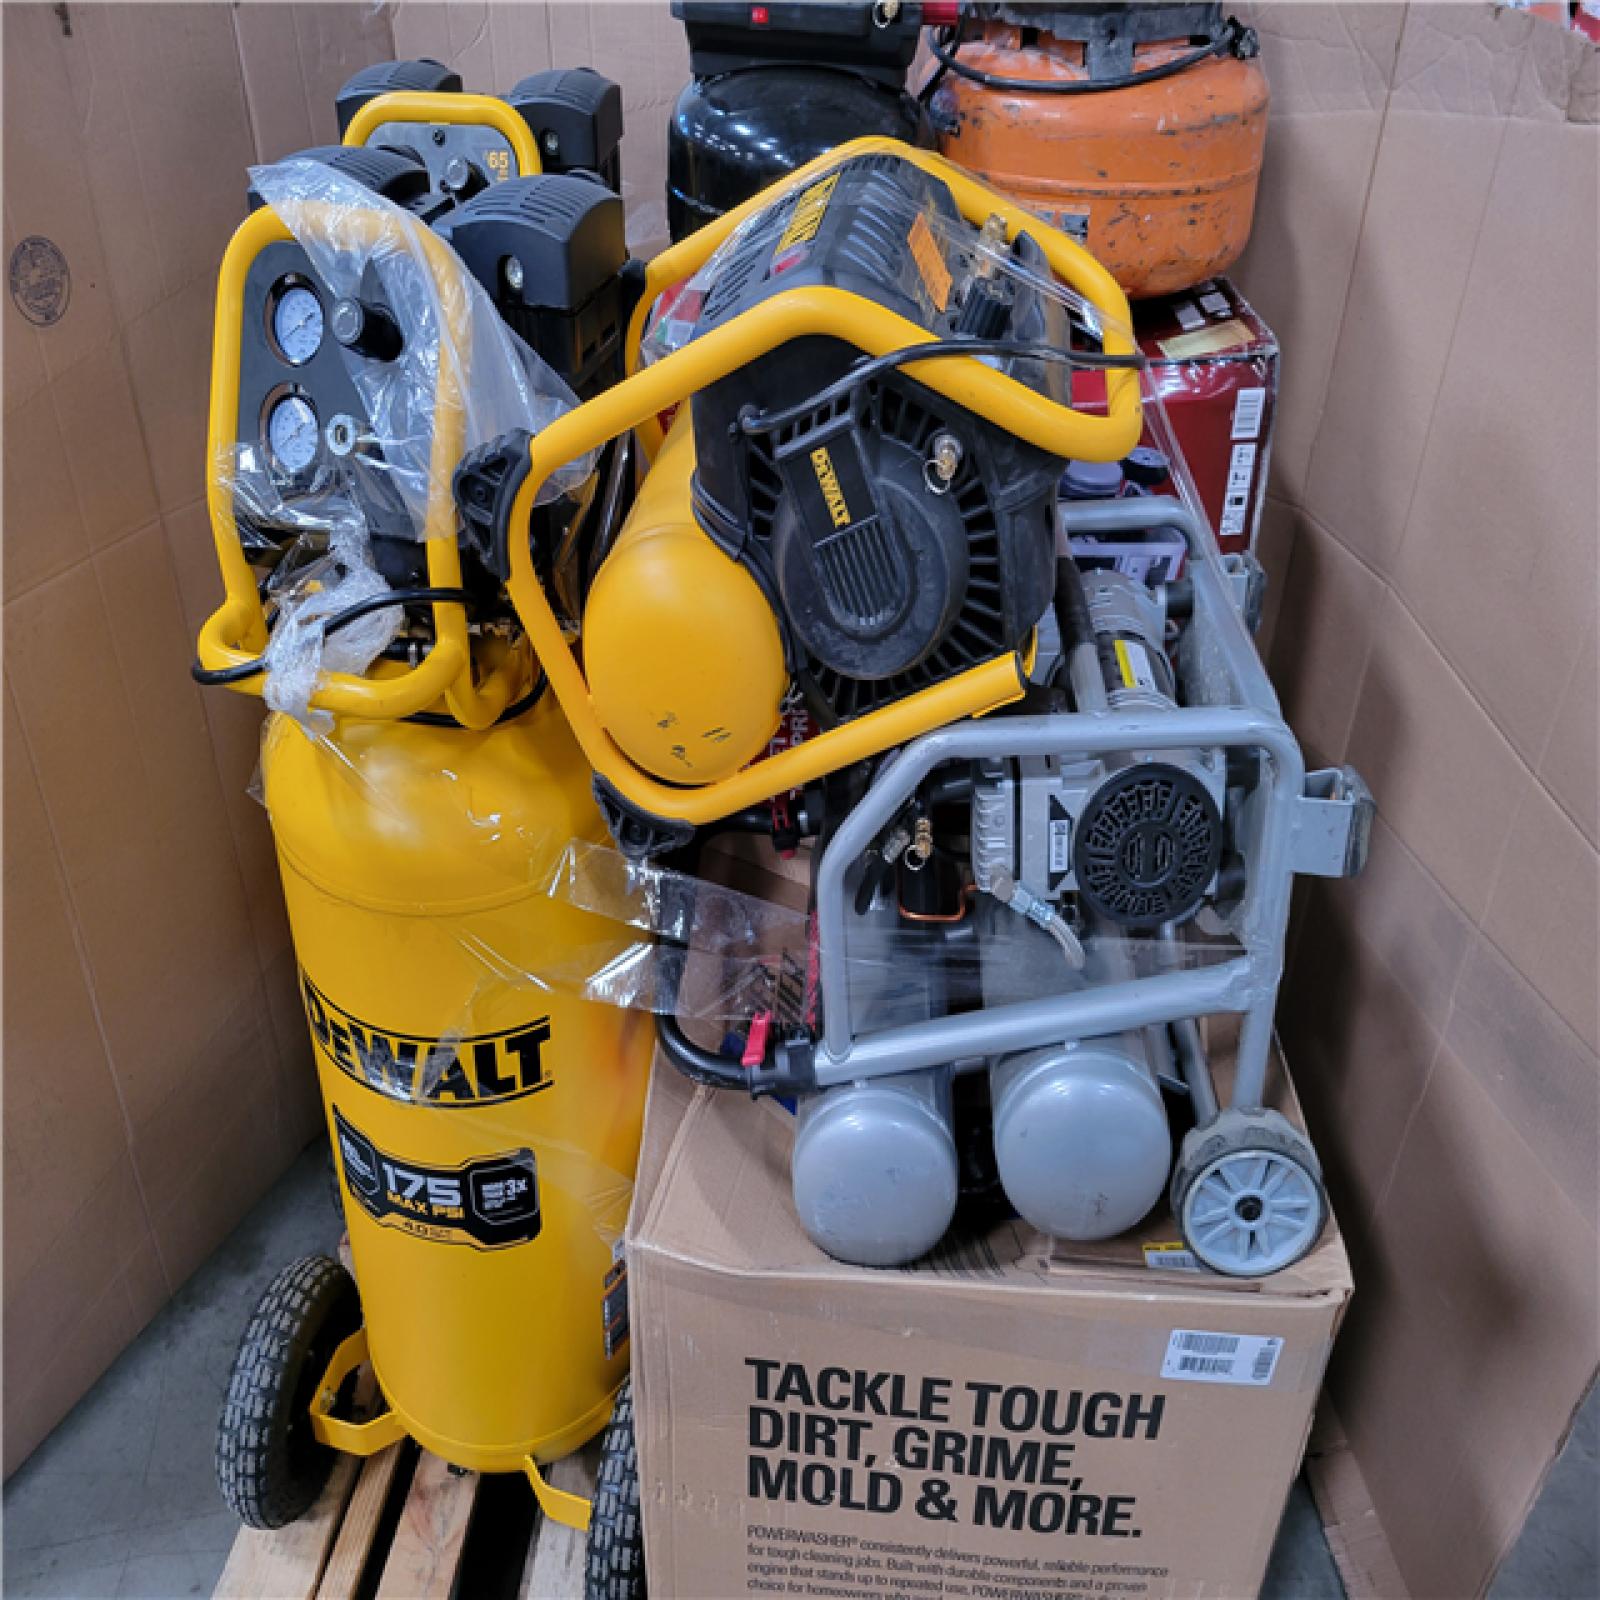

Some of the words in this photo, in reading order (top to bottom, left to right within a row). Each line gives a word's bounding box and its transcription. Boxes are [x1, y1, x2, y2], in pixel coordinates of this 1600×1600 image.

[809, 447, 852, 528] DEWALT
[304, 990, 551, 1101] DEWALT
[382, 1161, 462, 1207] 175
[386, 1190, 428, 1216] MAX
[431, 1204, 465, 1220] PSI
[744, 1357, 953, 1423] TACKLE
[965, 1381, 1167, 1440] TOUGH
[748, 1405, 877, 1468] DIRT,
[893, 1426, 1083, 1491] GRIME,
[747, 1455, 903, 1514] MOLD
[915, 1478, 959, 1523] &
[971, 1485, 1142, 1538] MORE.
[747, 1543, 763, 1556] for
[767, 1545, 800, 1561] tough
[802, 1550, 853, 1568] cleaning
[887, 1557, 913, 1571] Built
[916, 1562, 943, 1575] with
[944, 1565, 991, 1581] durable
[991, 1573, 1066, 1588] components
[1069, 1578, 1094, 1590] and
[1104, 1582, 1148, 1593] proven
[747, 1562, 788, 1577] engine
[789, 1564, 813, 1578] that
[817, 1568, 855, 1582] stands
[857, 1574, 873, 1586] up
[874, 1575, 888, 1586] to
[889, 1575, 943, 1592] repeated
[859, 1540, 931, 1560] consistently
[934, 1546, 980, 1563] delivers
[982, 1554, 1041, 1572] powerful,
[1042, 1559, 1090, 1573] reliable
[1091, 1562, 1169, 1578] performance
[747, 1579, 786, 1593] choice
[787, 1580, 804, 1593] for
[807, 1582, 882, 1600] homeowners
